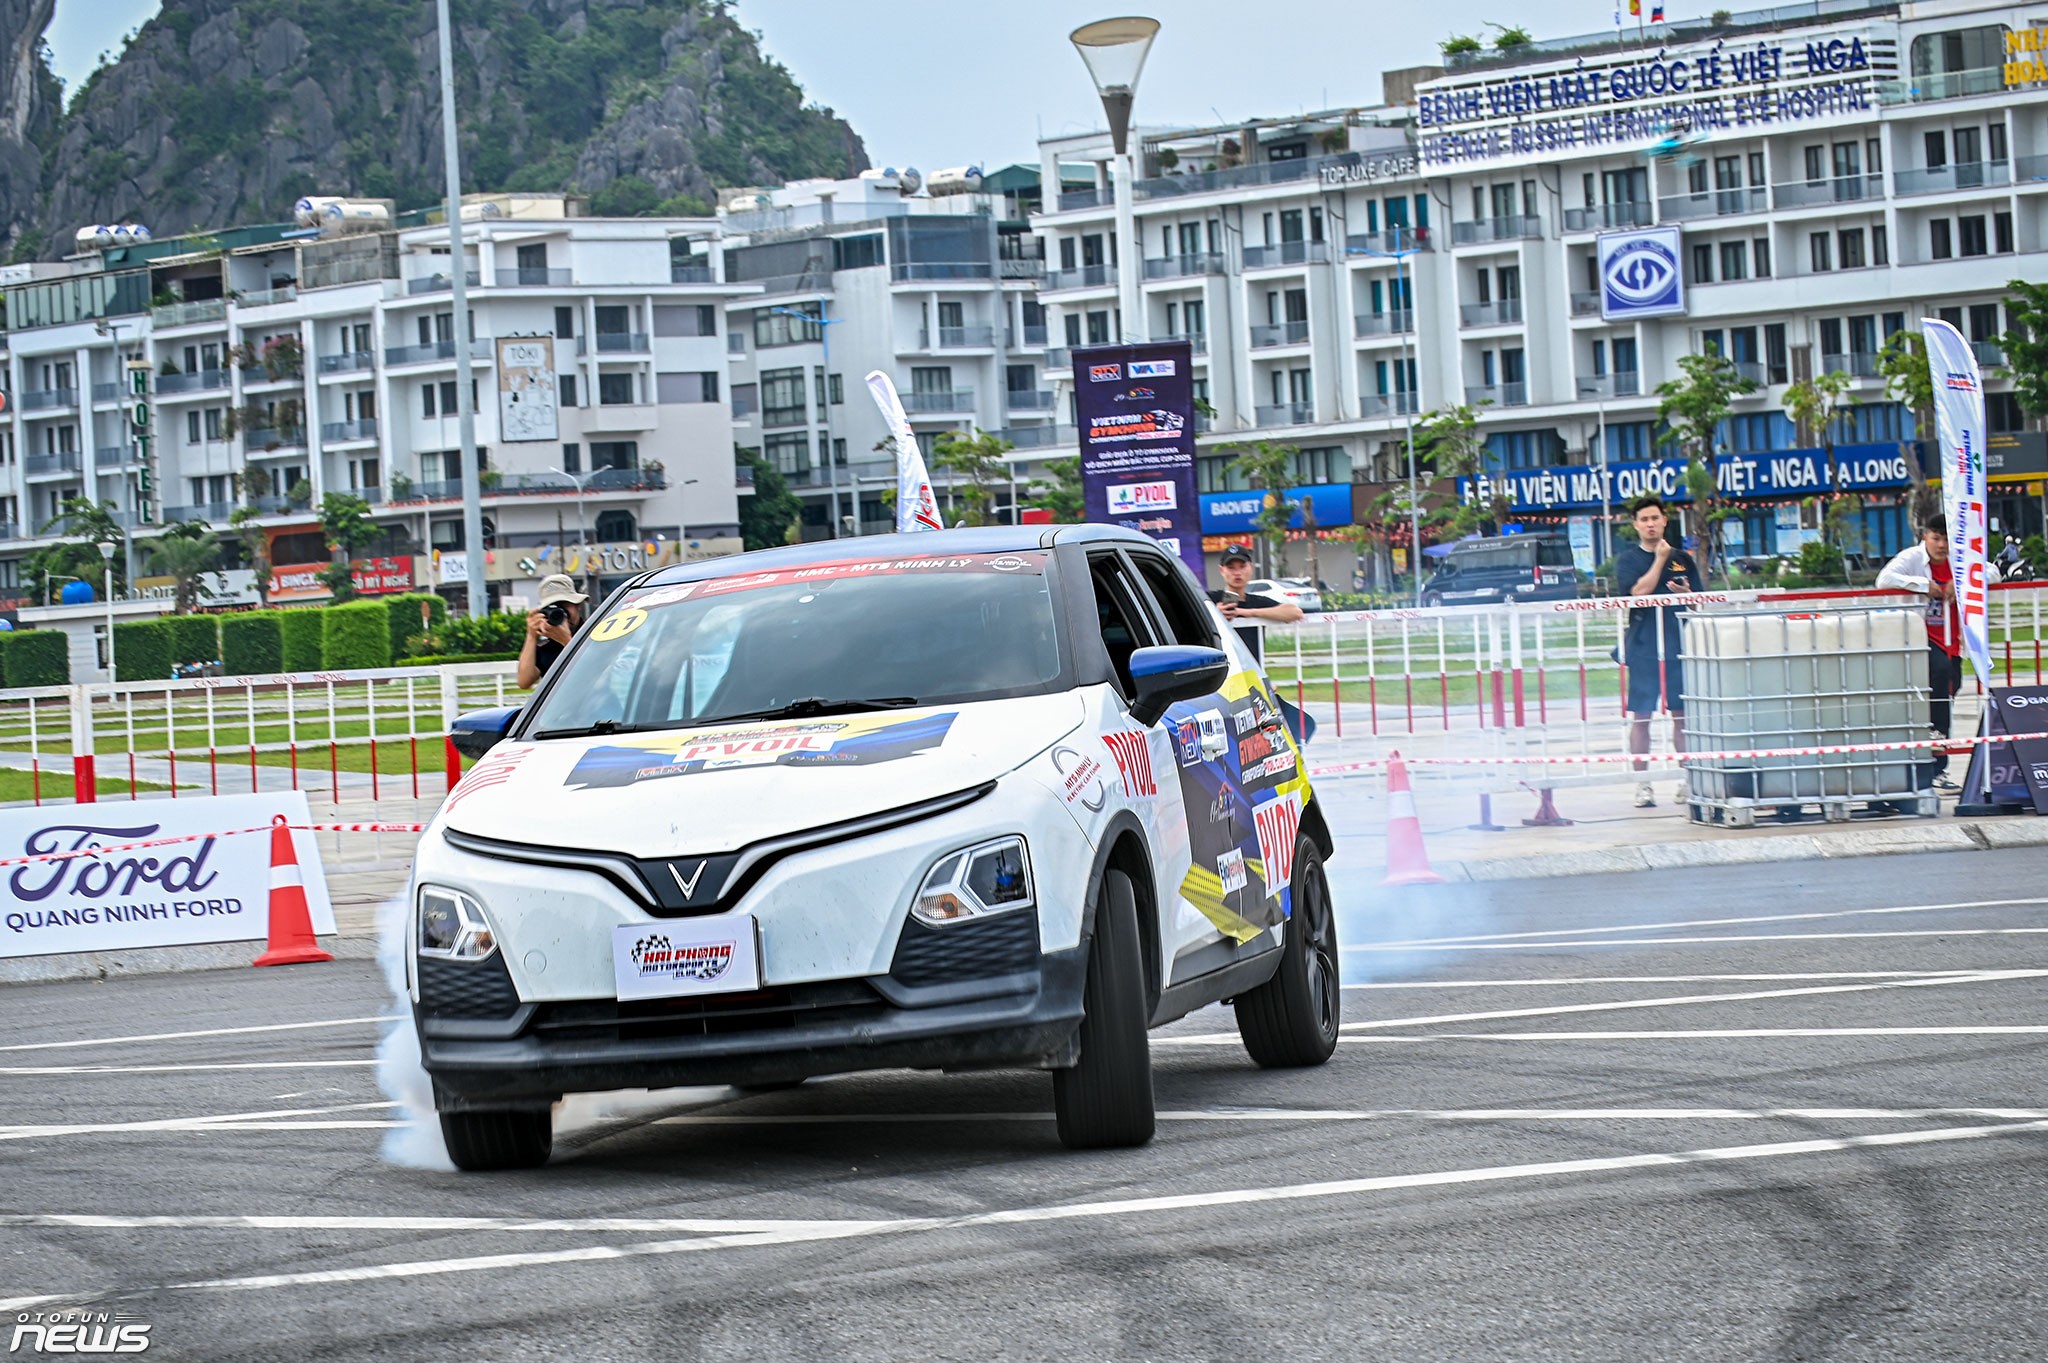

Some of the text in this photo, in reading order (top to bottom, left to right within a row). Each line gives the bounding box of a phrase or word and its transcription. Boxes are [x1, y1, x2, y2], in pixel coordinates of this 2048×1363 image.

[1419, 87, 1480, 128] BỆNH
[1487, 76, 1542, 119] VIỆN
[1610, 46, 1690, 100] QUỐC
[1696, 38, 1724, 88] TẾ
[1730, 41, 1783, 86] VIỆT
[1806, 37, 1867, 72] NGA
[1583, 99, 1730, 148] INTERNATIONAL
[1735, 93, 1771, 126] EYE
[1777, 82, 1870, 123] HOSPITAL
[132, 370, 154, 523] HOTEL
[1135, 485, 1172, 503] PVOIL
[1521, 470, 1568, 509] VIỆN
[1617, 459, 1676, 499] QUỐC
[1770, 457, 1818, 489] NGA
[1853, 457, 1908, 484] LONG
[793, 566, 834, 580] HMC
[850, 561, 892, 574] MTS
[894, 559, 946, 570] MINH
[948, 557, 973, 569] LÝ
[1635, 597, 1673, 609] GIAO
[602, 615, 639, 634] 11
[685, 736, 821, 760] PVOIL
[1101, 730, 1158, 799] PVOIL
[1256, 799, 1299, 890] PVOIL
[10, 823, 220, 902] Ford
[6, 898, 243, 932] QUANG NINH FORD
[642, 960, 718, 973] MOTORSPORTS
[644, 949, 672, 964] HAI
[675, 970, 697, 979] CLUB
